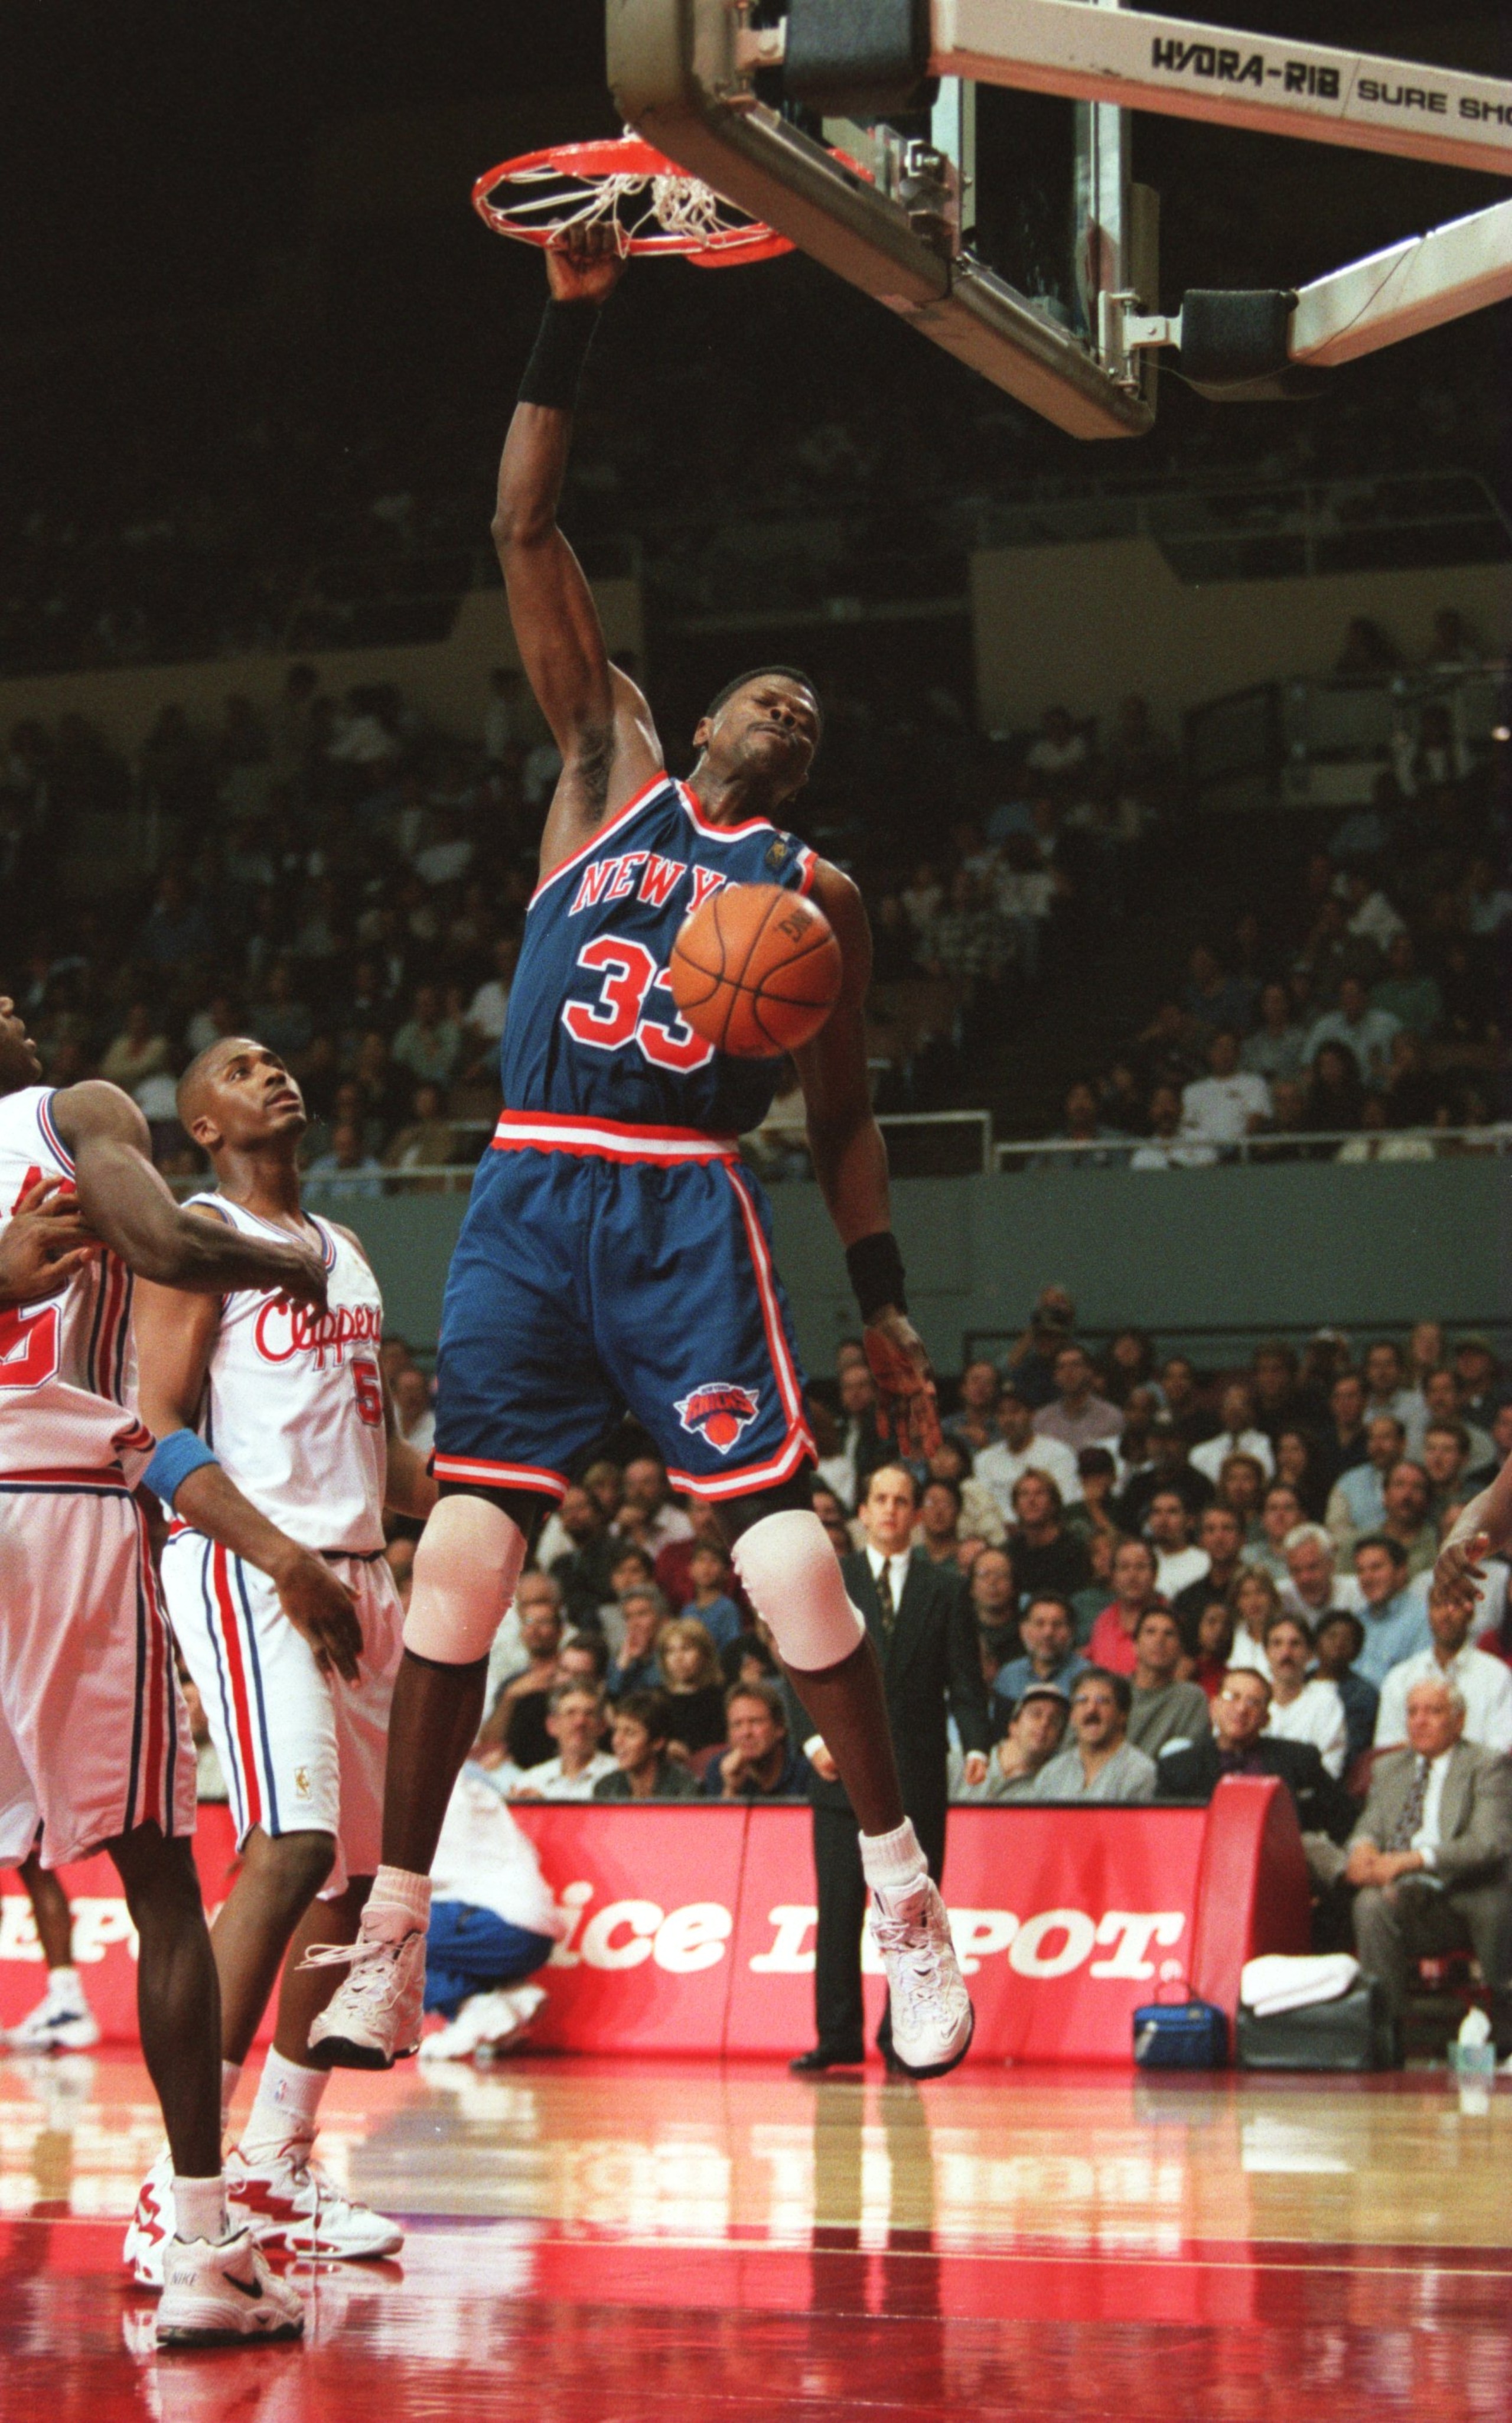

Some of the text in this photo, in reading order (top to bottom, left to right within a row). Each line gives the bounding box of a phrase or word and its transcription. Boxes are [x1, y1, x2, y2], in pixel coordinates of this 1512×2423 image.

[1152, 37, 1340, 100] HYDRA-RIB
[1358, 79, 1448, 114] SURE
[568, 851, 687, 916] NEW
